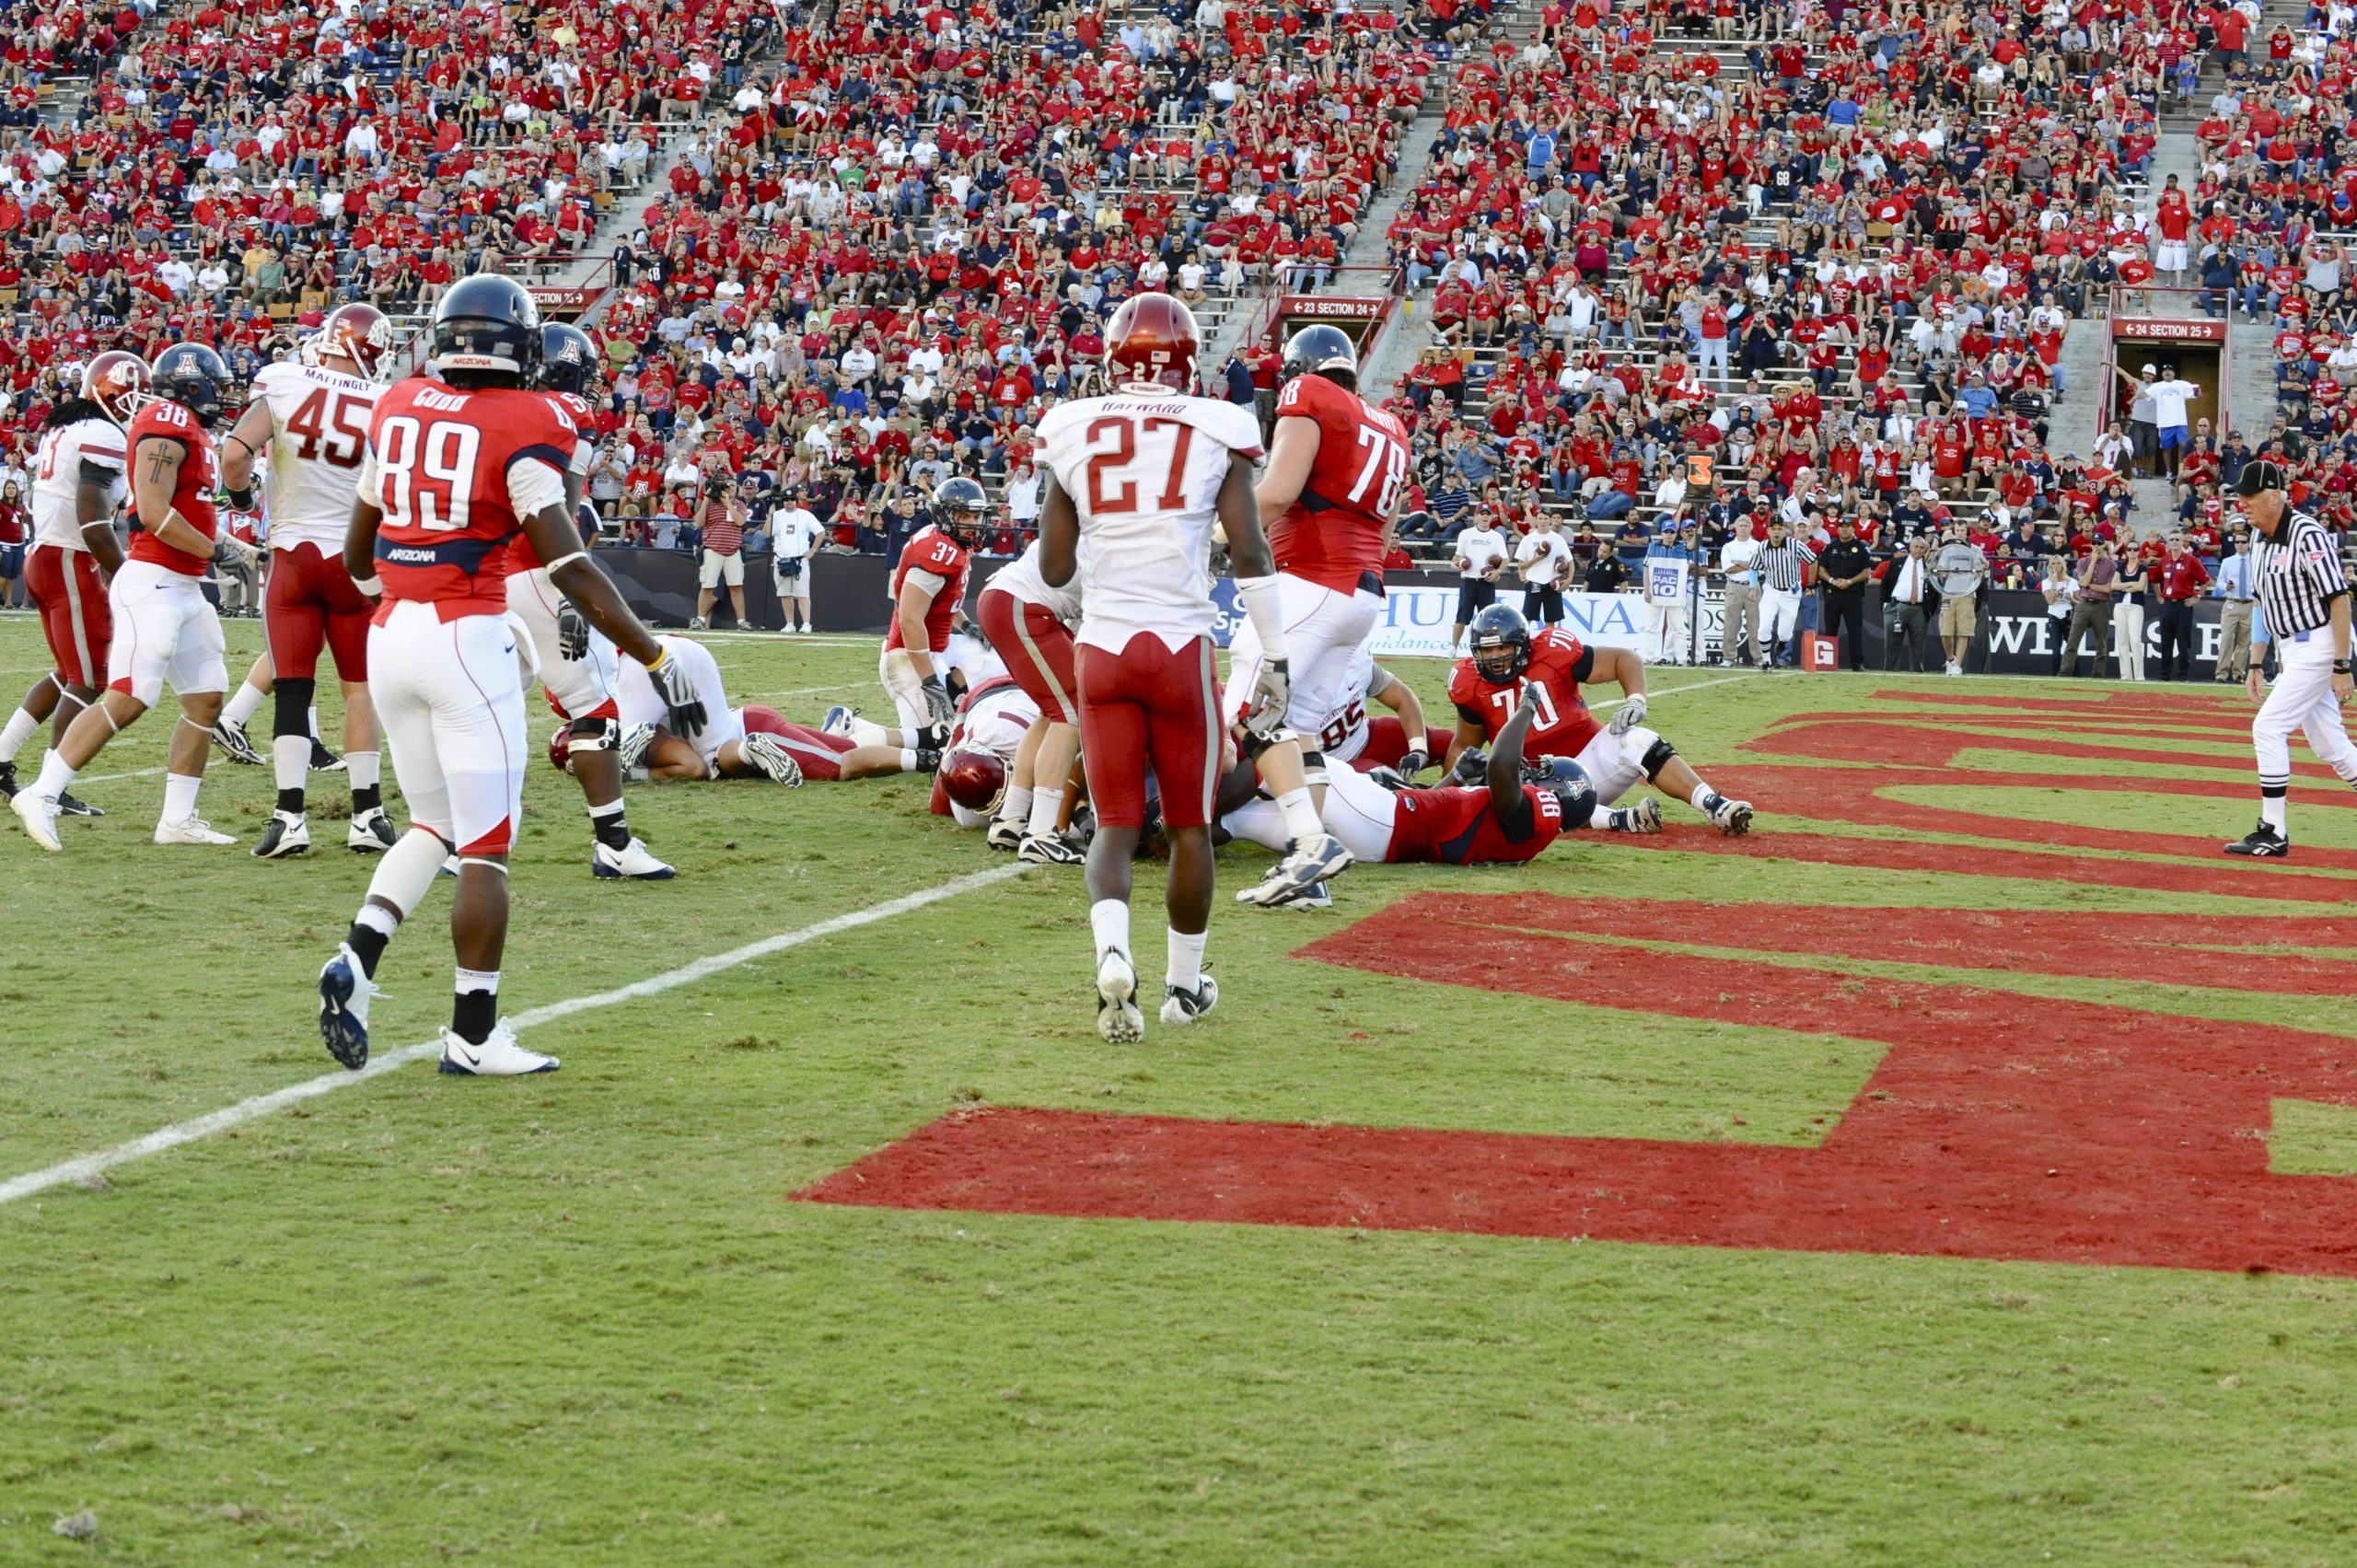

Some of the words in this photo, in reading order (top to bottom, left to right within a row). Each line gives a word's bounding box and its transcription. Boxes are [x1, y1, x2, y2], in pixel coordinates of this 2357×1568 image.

[1775, 171, 1790, 187] 68
[529, 292, 562, 304] ECTION
[1304, 301, 1316, 314] 23
[1318, 302, 1354, 315] SECTION
[1356, 303, 1368, 316] 24
[2135, 323, 2147, 336] 24
[2150, 324, 2188, 337] SECTION
[2190, 325, 2202, 338] 25
[451, 356, 493, 366] ARIZONA
[1132, 361, 1164, 382] 27
[304, 368, 372, 391] MATTINGLY
[155, 401, 189, 428] 38
[285, 387, 374, 470] 45
[376, 415, 482, 532] 89
[1086, 415, 1196, 516] 27
[1346, 423, 1407, 517] 78
[1687, 455, 1713, 486] 3
[1903, 528, 1915, 545] 5
[387, 549, 436, 563] ARIZONA
[930, 540, 958, 566] 37
[1653, 584, 1677, 595] 10
[1375, 592, 1640, 634] HUNA
[1366, 630, 1452, 650] uidance
[1815, 640, 1835, 666] G
[1491, 679, 1561, 733] 70
[1320, 699, 1365, 752] 85
[1535, 790, 1563, 819] 88
